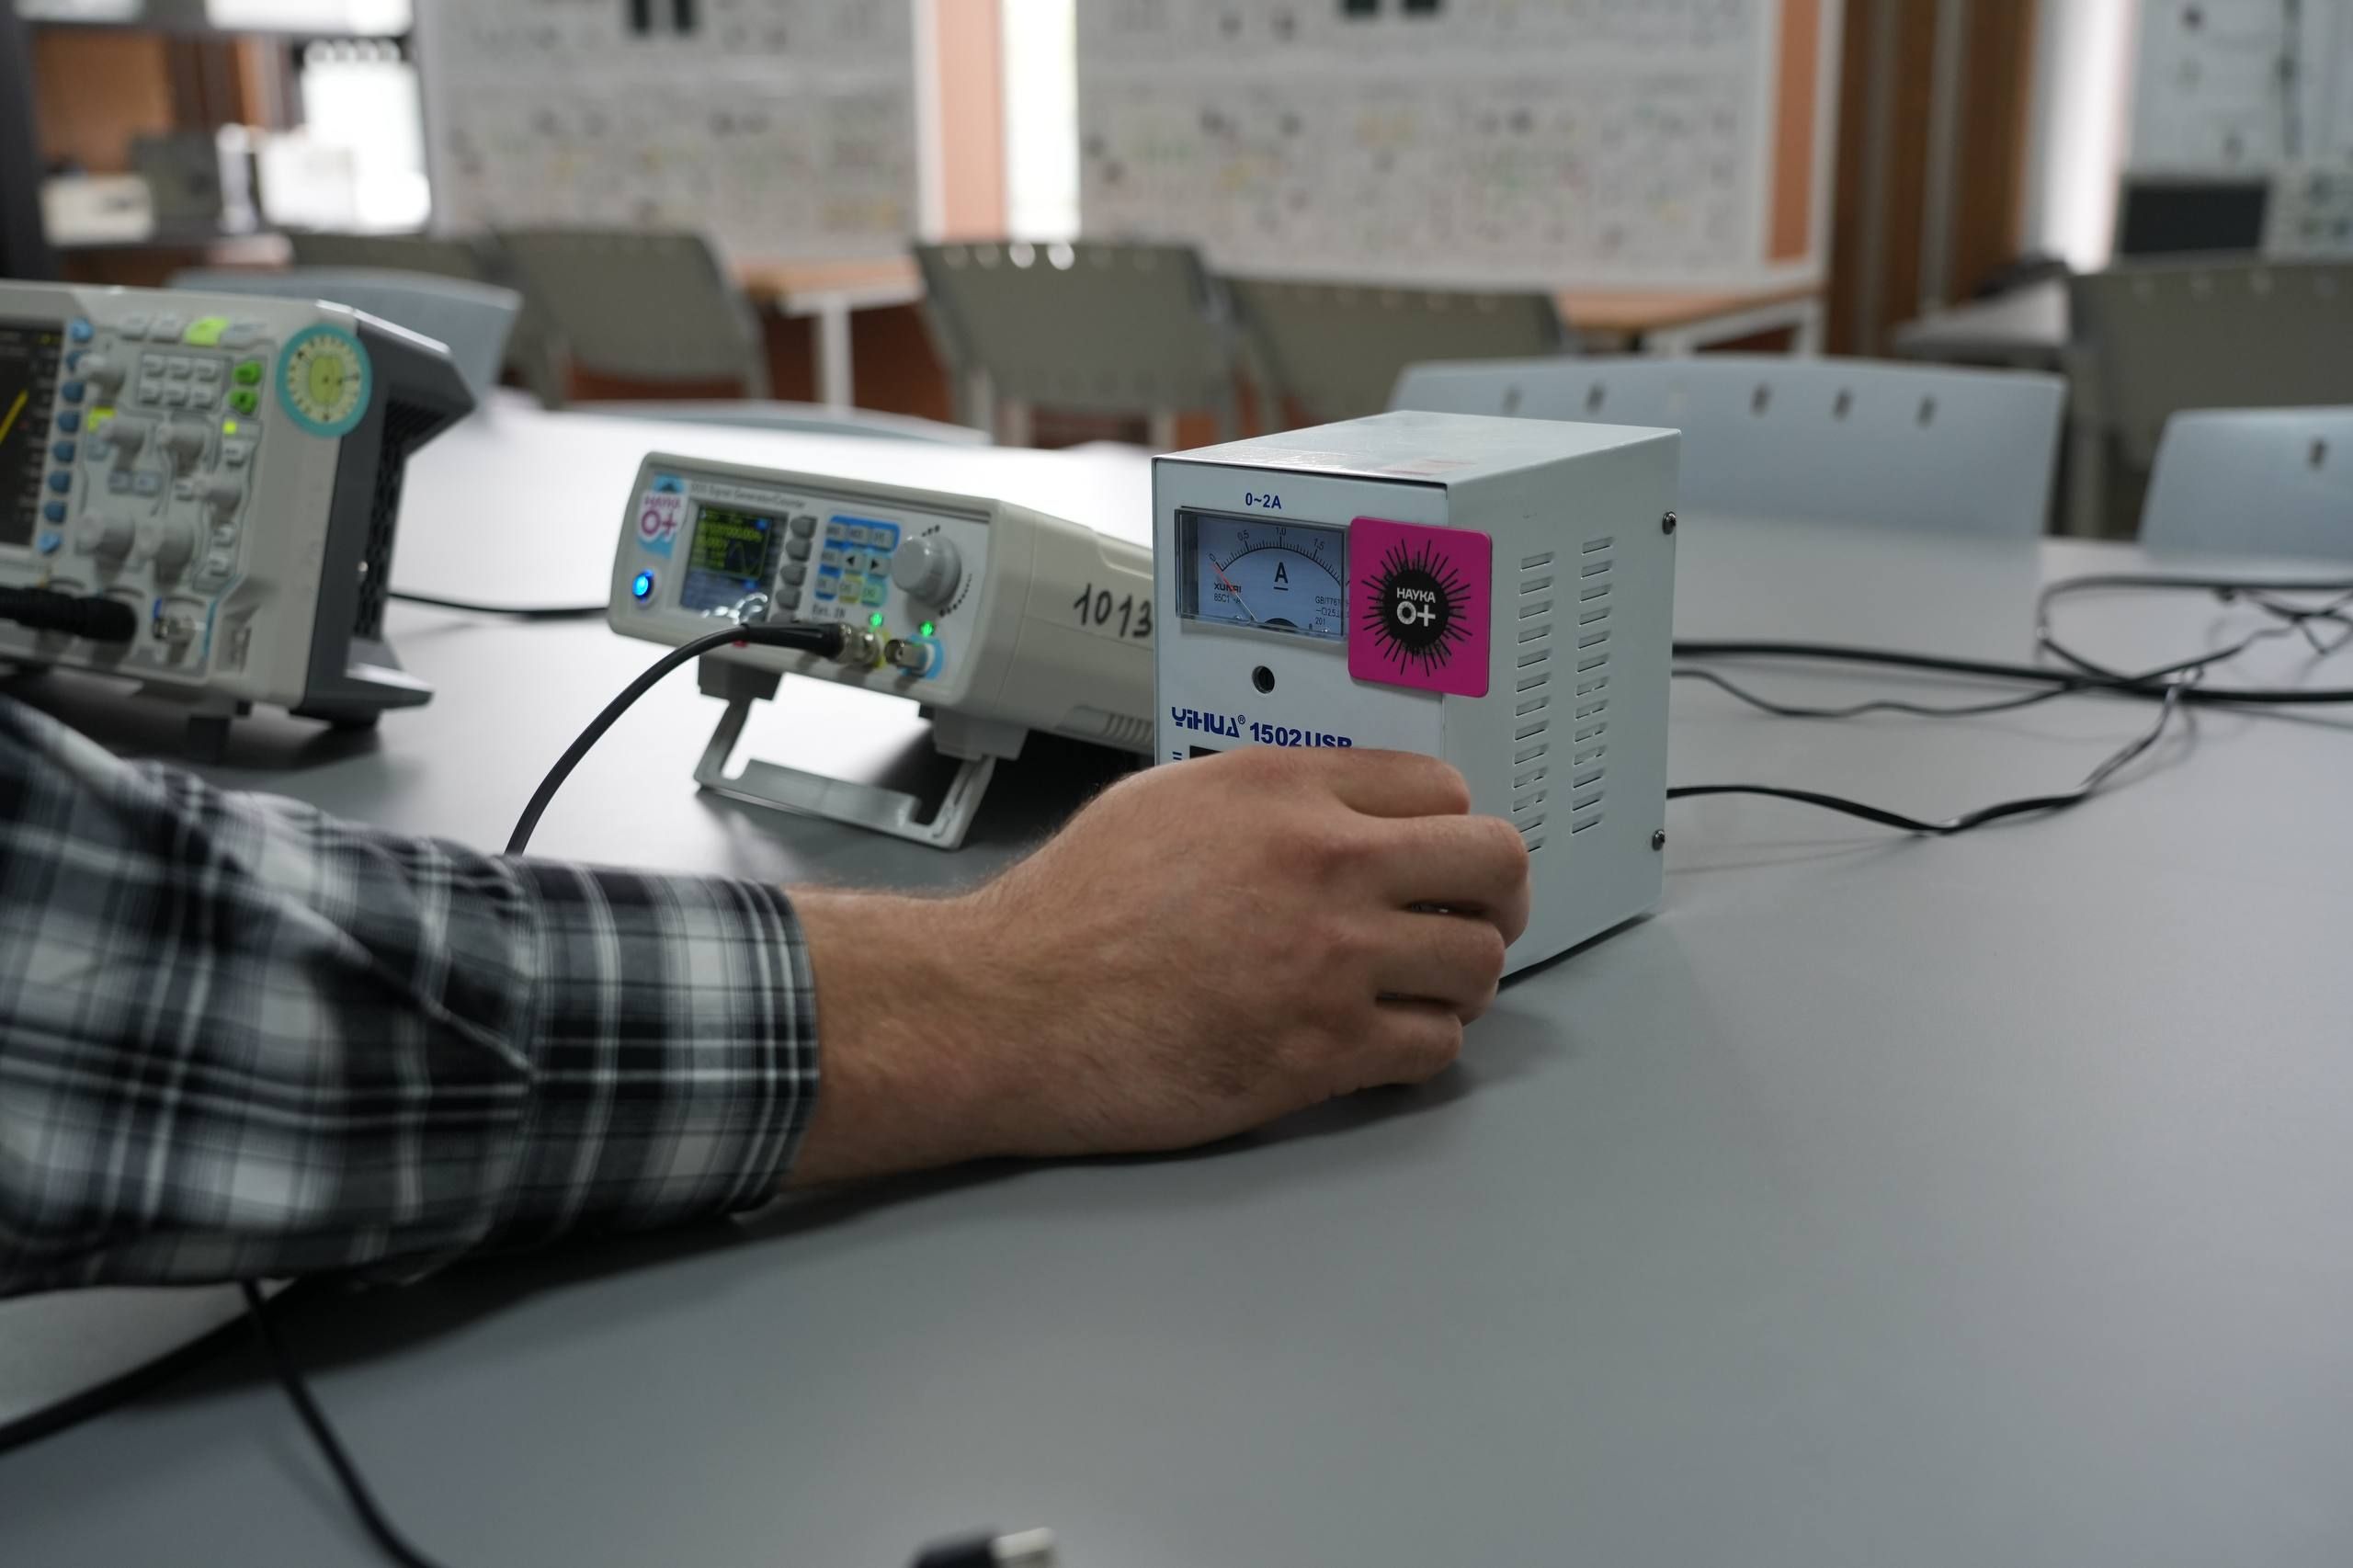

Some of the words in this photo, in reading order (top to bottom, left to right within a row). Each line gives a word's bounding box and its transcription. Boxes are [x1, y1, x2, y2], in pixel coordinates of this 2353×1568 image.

[1245, 492, 1281, 509] 0~2A
[1274, 562, 1289, 584] A
[1396, 586, 1436, 604] НАУКА
[1073, 583, 1153, 638] 1013
